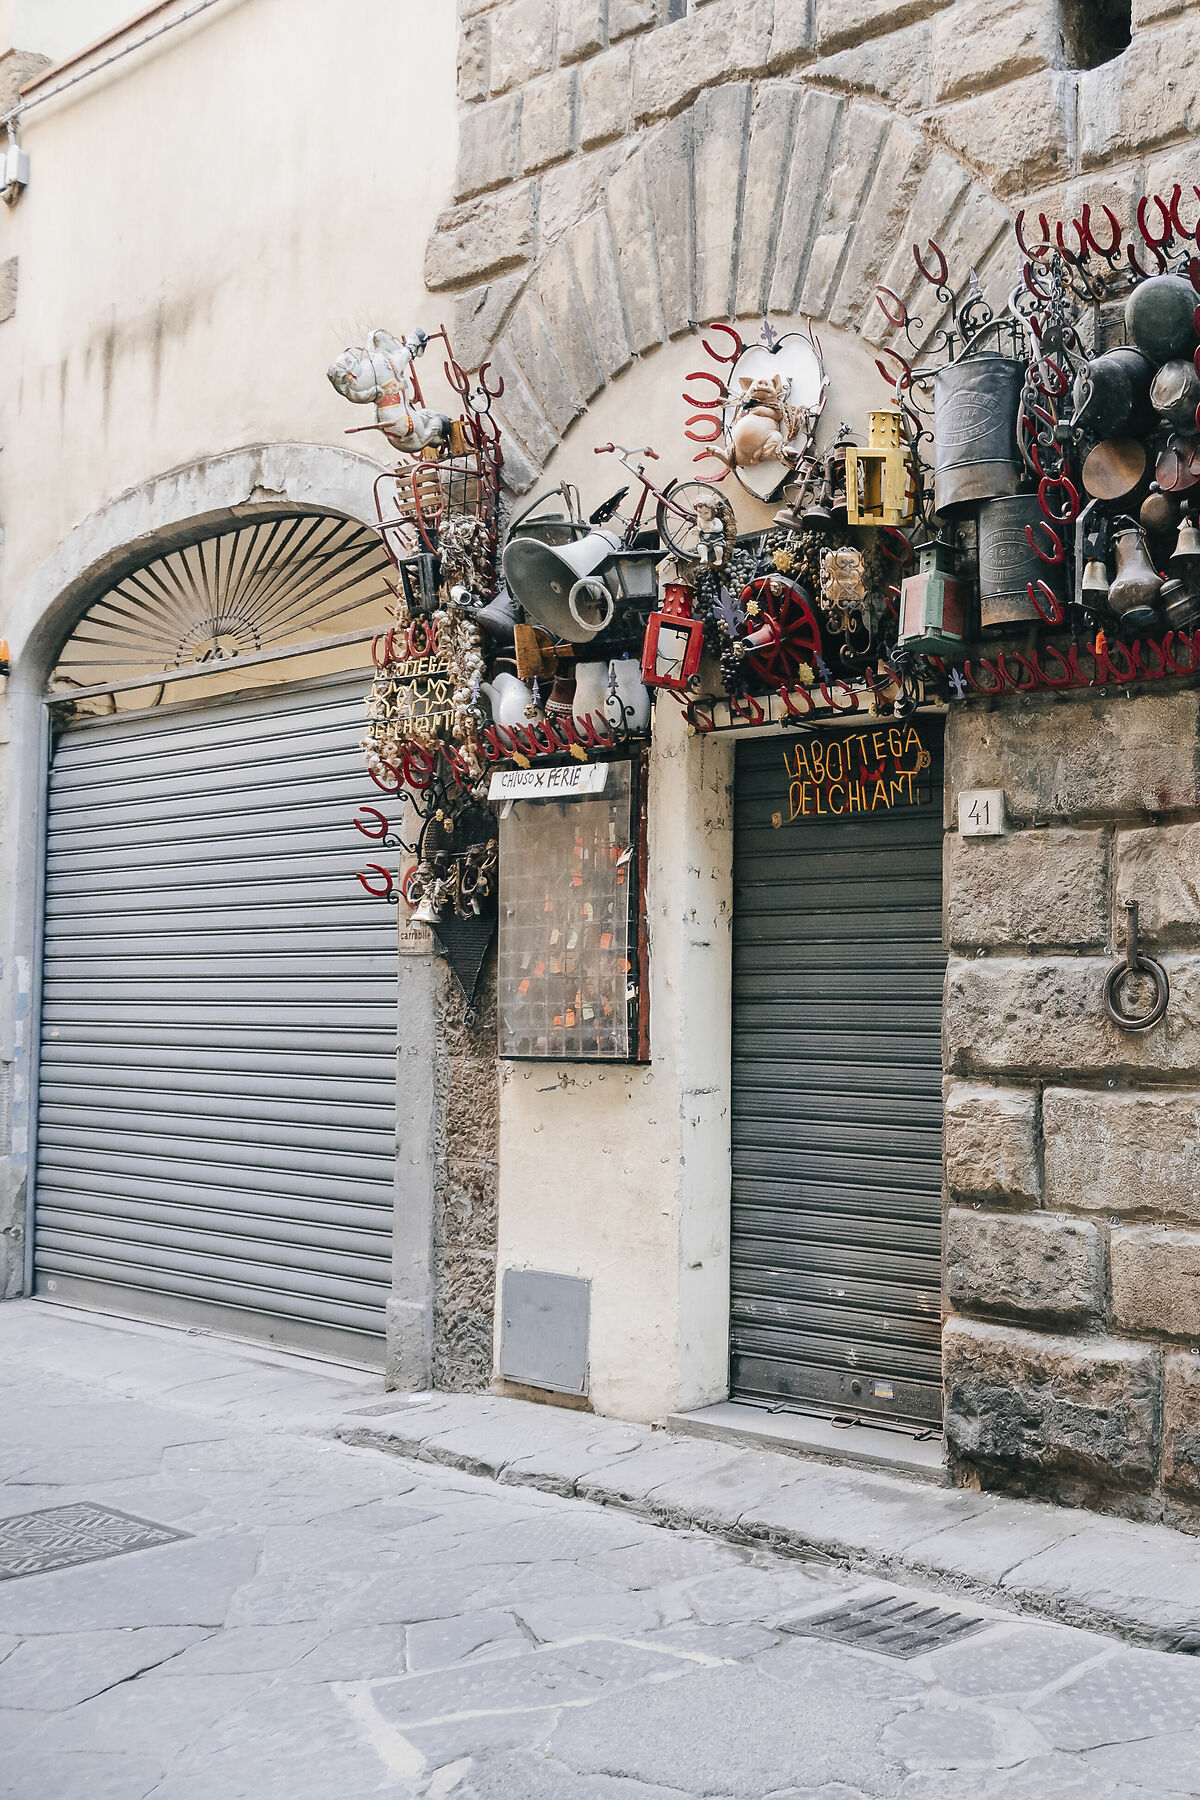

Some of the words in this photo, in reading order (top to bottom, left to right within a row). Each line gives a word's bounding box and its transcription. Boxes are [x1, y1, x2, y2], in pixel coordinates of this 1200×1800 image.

[501, 771, 534, 788] CHIUSO
[546, 766, 582, 788] FERIE
[967, 799, 991, 826] 41
